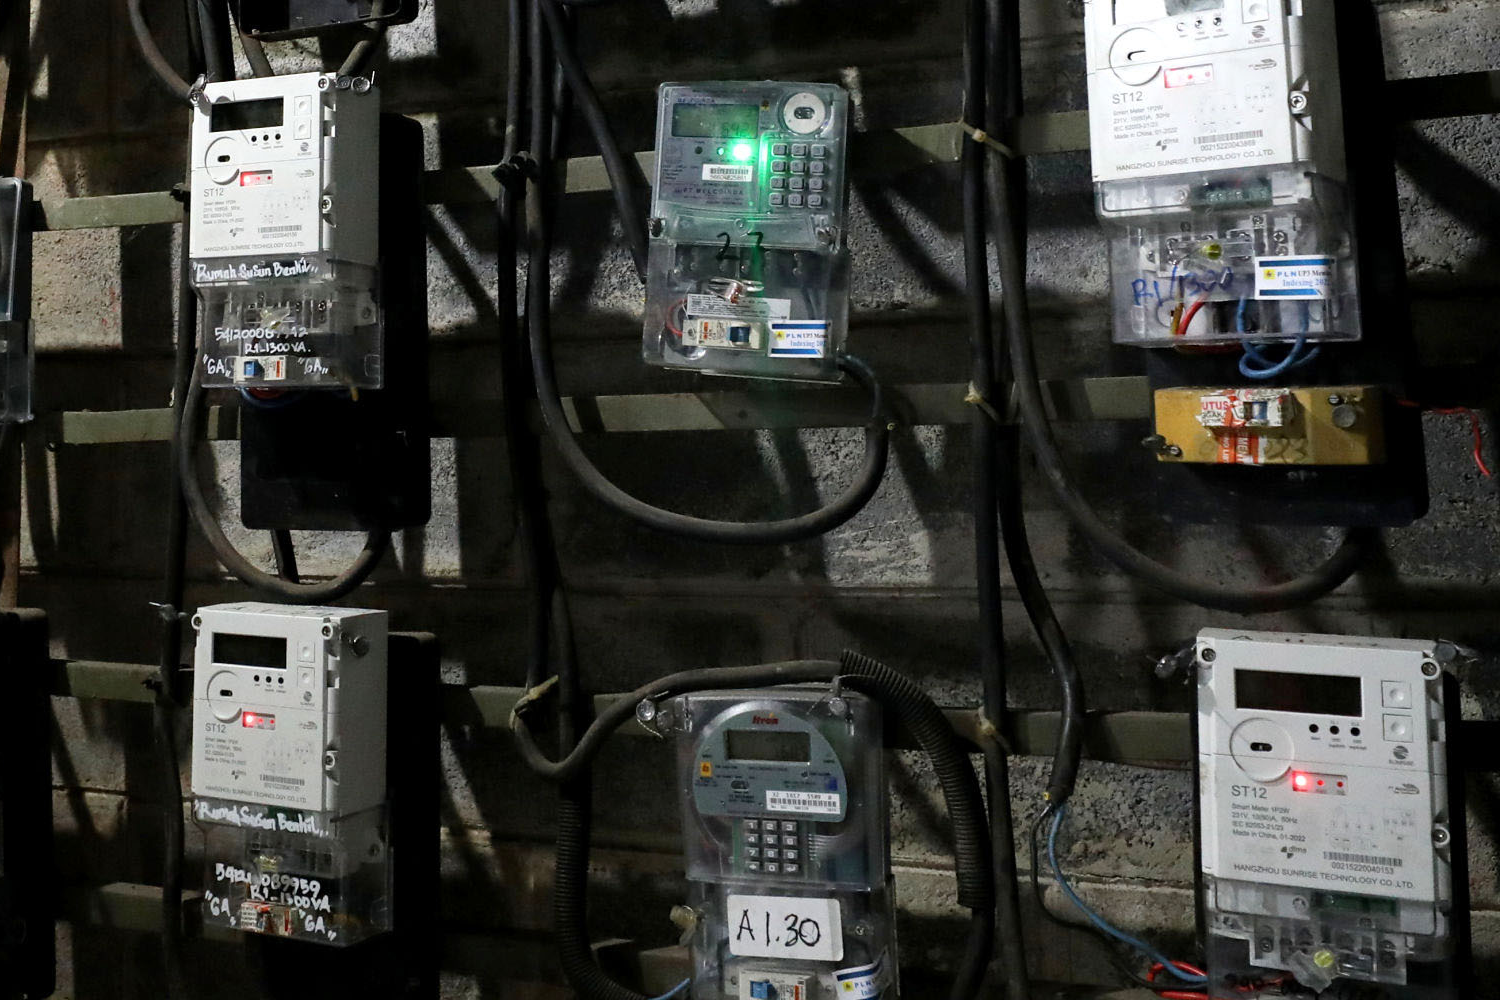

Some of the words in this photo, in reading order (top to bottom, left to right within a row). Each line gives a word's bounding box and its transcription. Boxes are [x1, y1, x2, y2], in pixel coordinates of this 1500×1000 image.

[1112, 90, 1143, 105] ST12
[1116, 160, 1156, 172] HANGZHOU
[1157, 157, 1190, 168] SUNRISE
[1191, 151, 1241, 164] TECHNOLOGY
[203, 187, 224, 198] ST12
[1277, 270, 1297, 278] PLN
[1282, 278, 1314, 288] Indexing
[204, 722, 227, 734] ST12
[1231, 784, 1268, 800] ST12
[1233, 863, 1281, 876] HANGZHOU
[1281, 868, 1319, 880] SUNRISE
[1319, 872, 1379, 887] TECHNOLOGY
